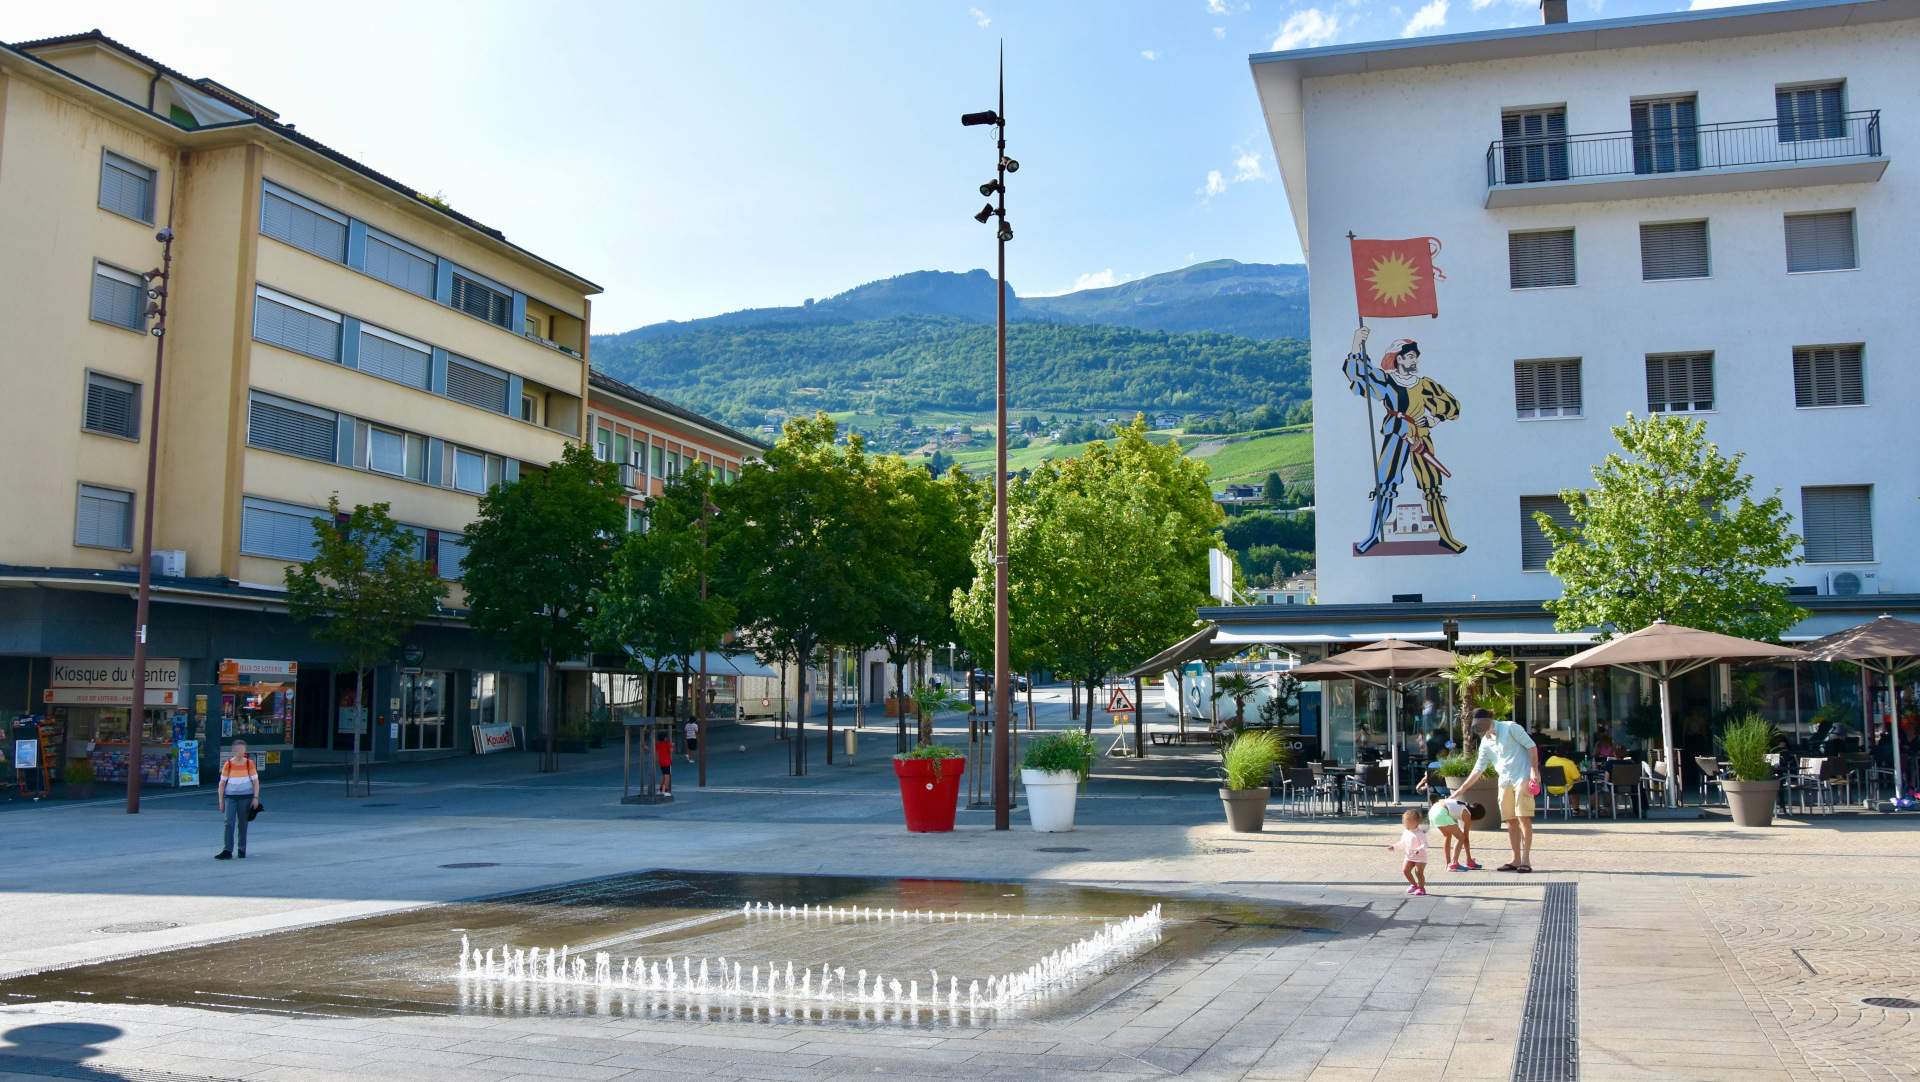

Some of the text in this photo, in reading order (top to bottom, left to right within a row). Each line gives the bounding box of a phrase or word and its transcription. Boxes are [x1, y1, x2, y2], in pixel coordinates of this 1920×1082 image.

[55, 666, 177, 685] Kiosque du entre
[262, 665, 283, 673] LOTERIE
